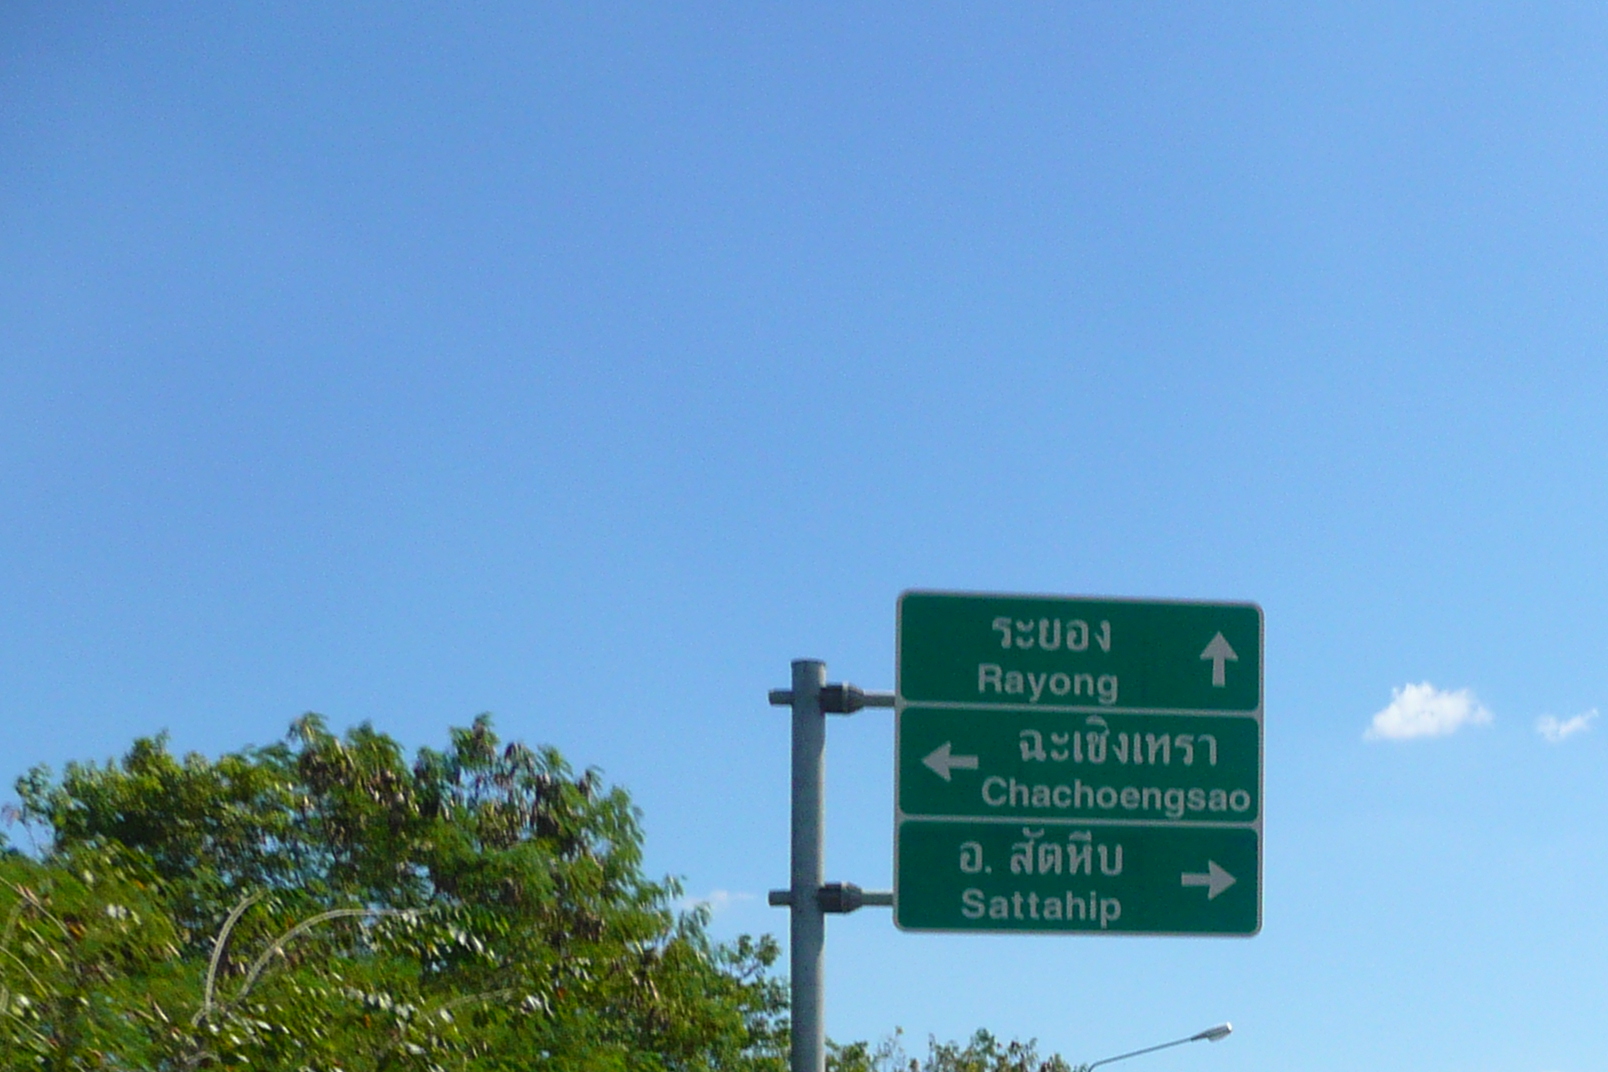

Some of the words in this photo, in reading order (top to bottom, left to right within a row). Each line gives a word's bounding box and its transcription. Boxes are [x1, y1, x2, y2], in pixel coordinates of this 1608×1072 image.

[992, 616, 1112, 652] ระยอง
[978, 663, 1119, 705] Rayong
[1019, 715, 1218, 766] ฉะเชิงเทรา
[981, 776, 1251, 819] Chachoengsao
[959, 841, 992, 874] อ.
[961, 888, 1122, 928] Sattahip
